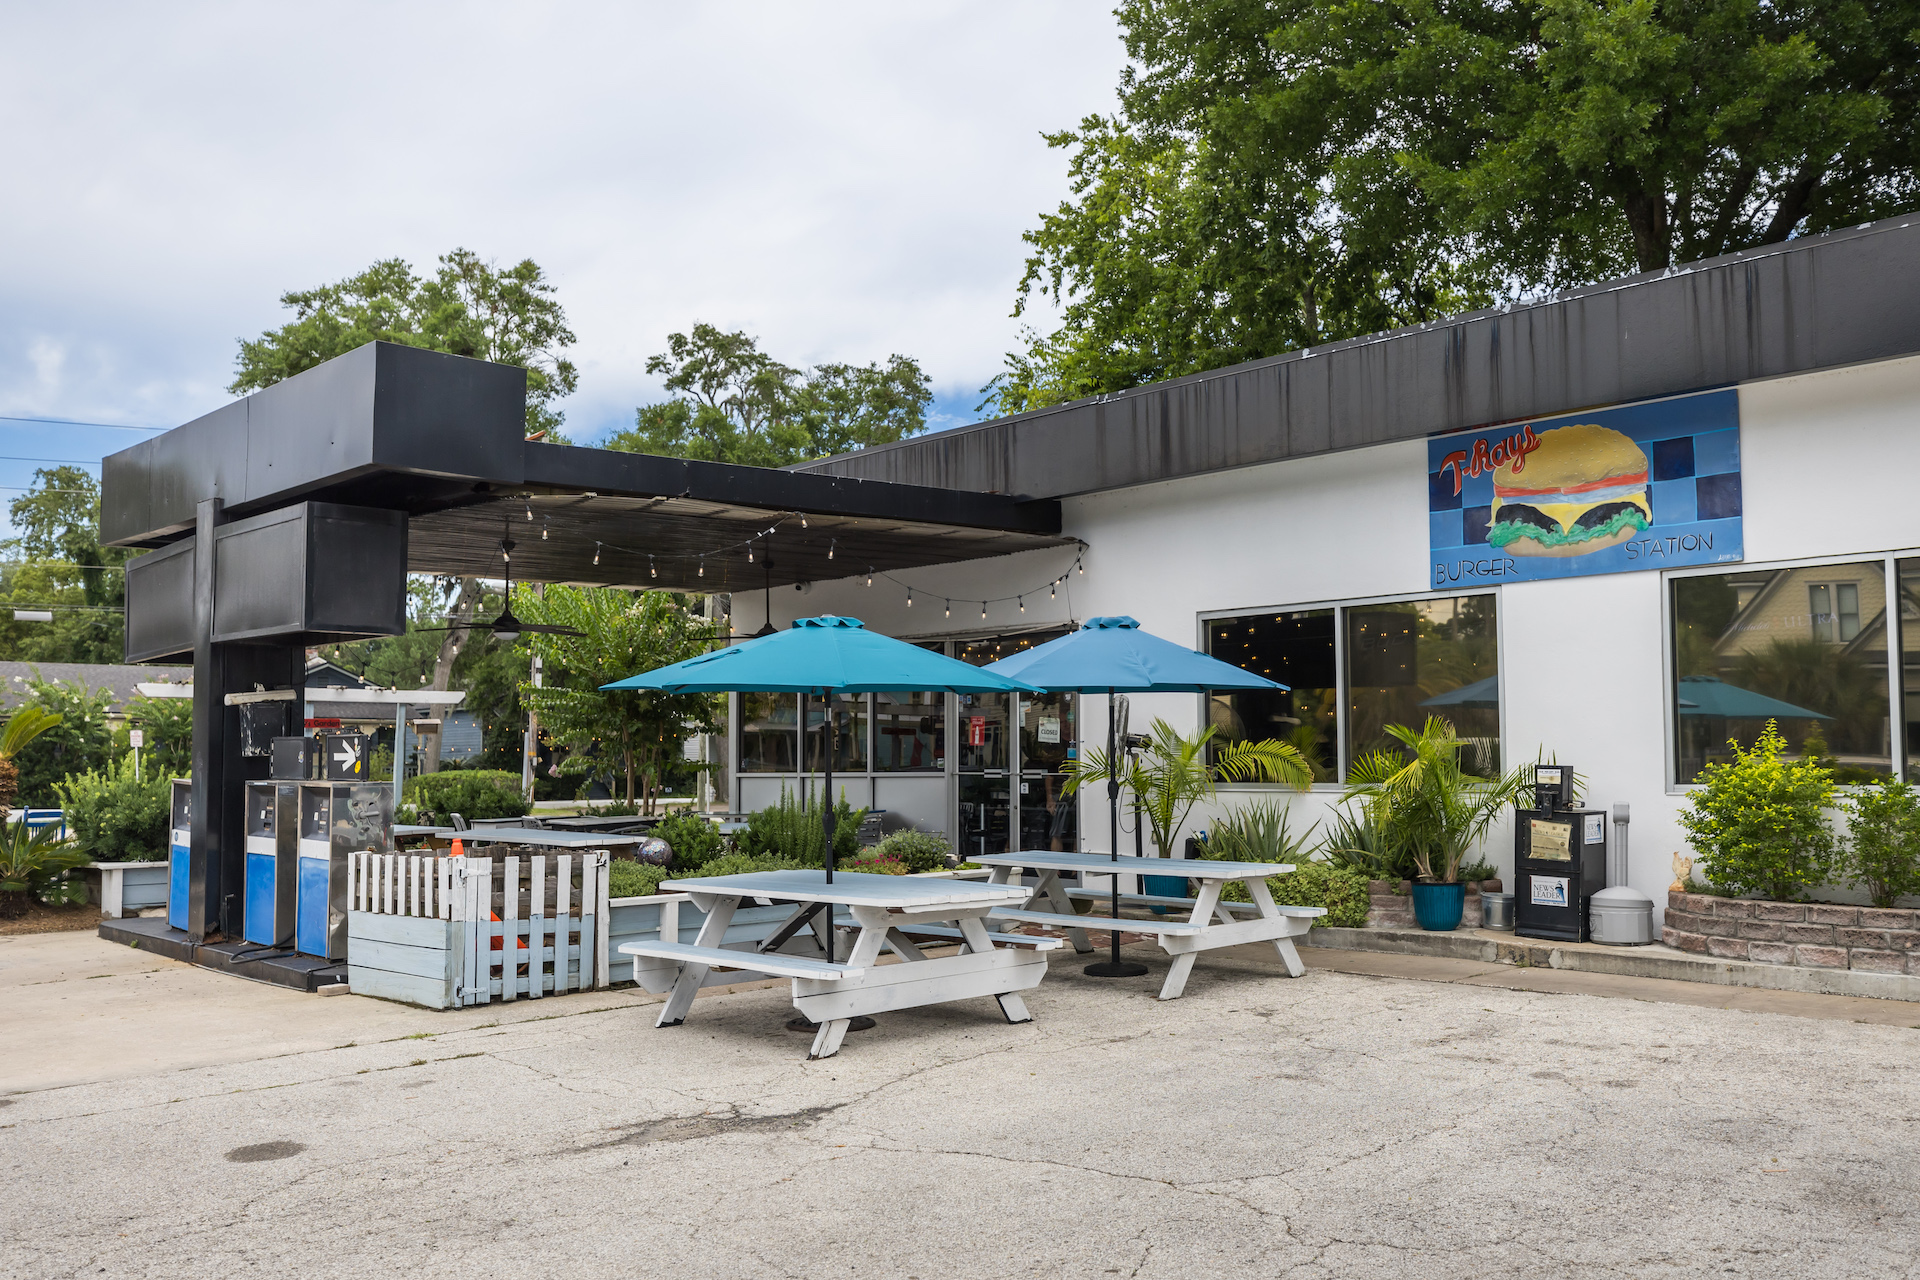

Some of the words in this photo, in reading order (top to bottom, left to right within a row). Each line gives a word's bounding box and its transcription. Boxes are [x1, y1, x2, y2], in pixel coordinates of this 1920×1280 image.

[1435, 558, 1519, 585] BURGER
[1624, 531, 1713, 560] STATION
[1784, 613, 1839, 627] ULTRA
[313, 719, 340, 727] Garden
[1533, 884, 1555, 892] NEWS
[1533, 891, 1561, 899] LEADER
